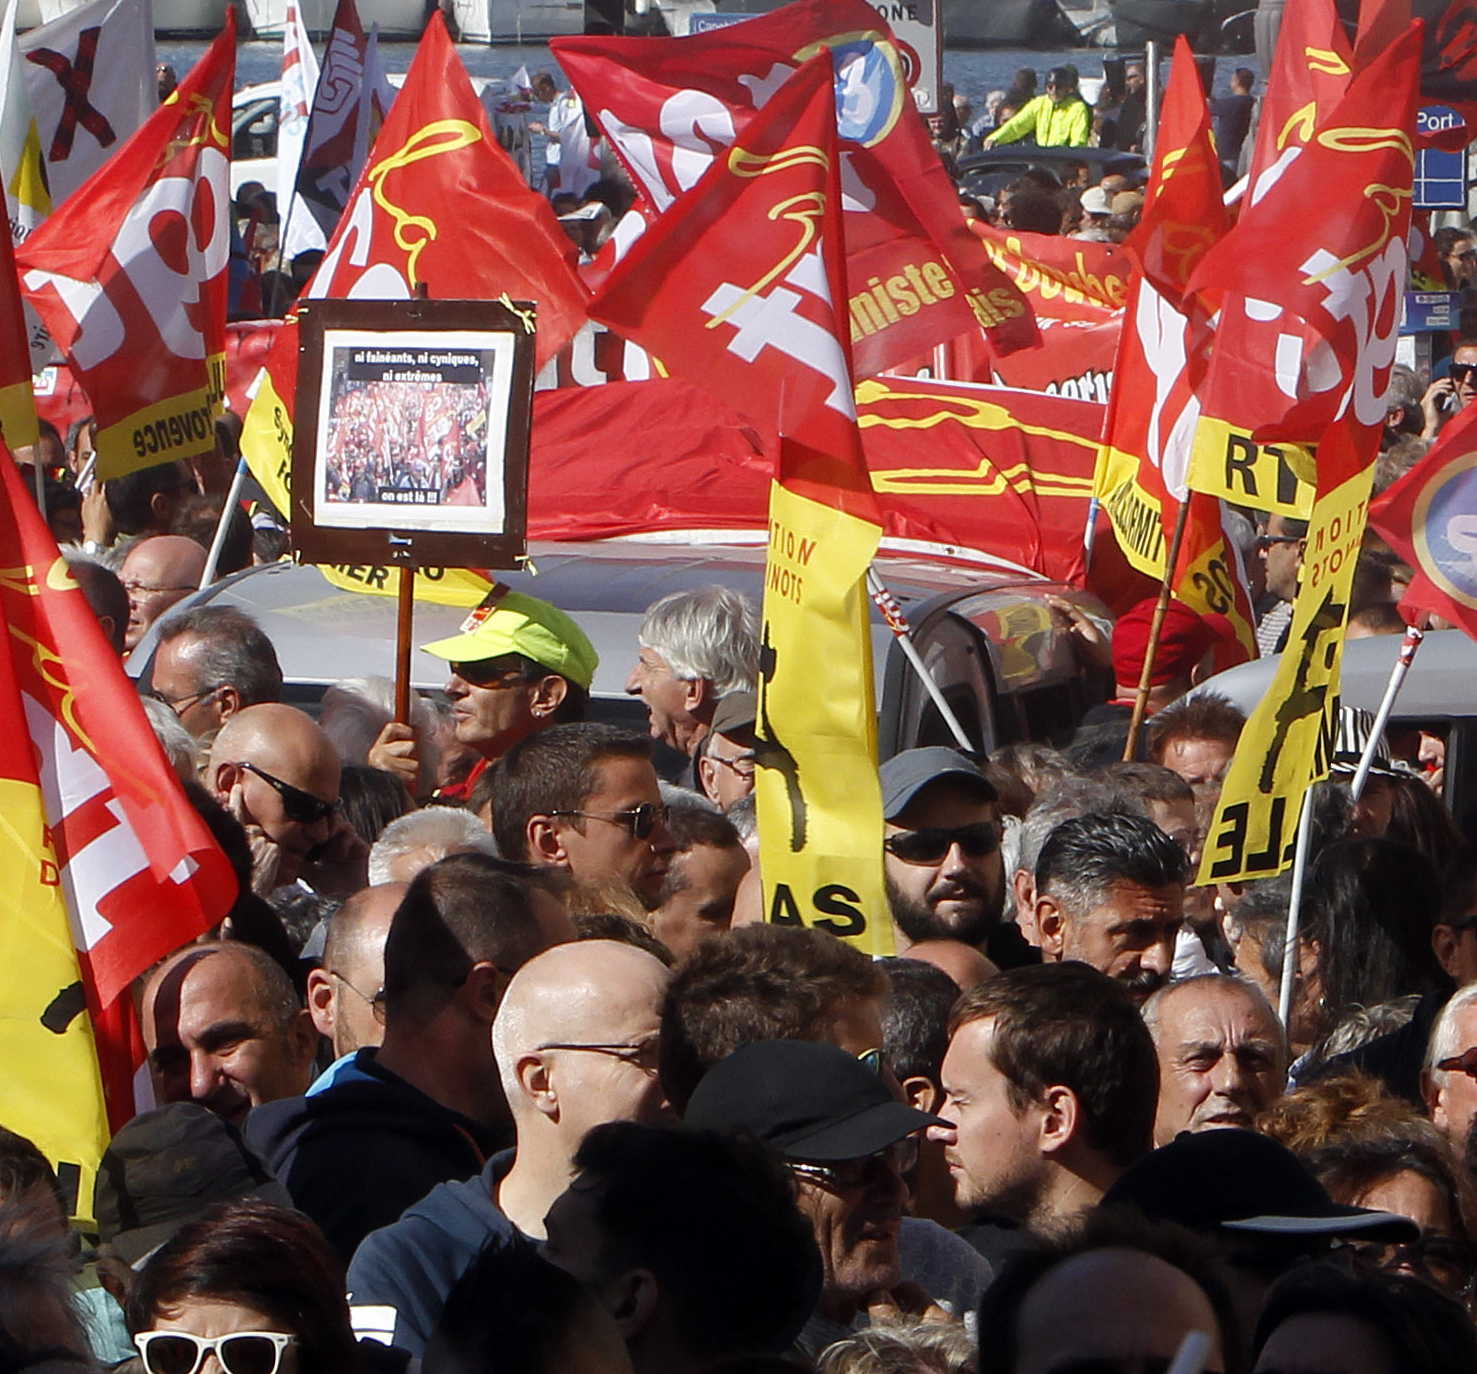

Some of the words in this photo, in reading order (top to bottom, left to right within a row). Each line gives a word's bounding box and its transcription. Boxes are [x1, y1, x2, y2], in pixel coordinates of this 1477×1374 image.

[876, 4, 918, 22] ONE
[354, 351, 365, 363] ni
[418, 352, 429, 364] ni
[430, 354, 480, 369] cyniques,
[382, 369, 394, 382] ni
[381, 492, 395, 503] on
[396, 491, 413, 503] est
